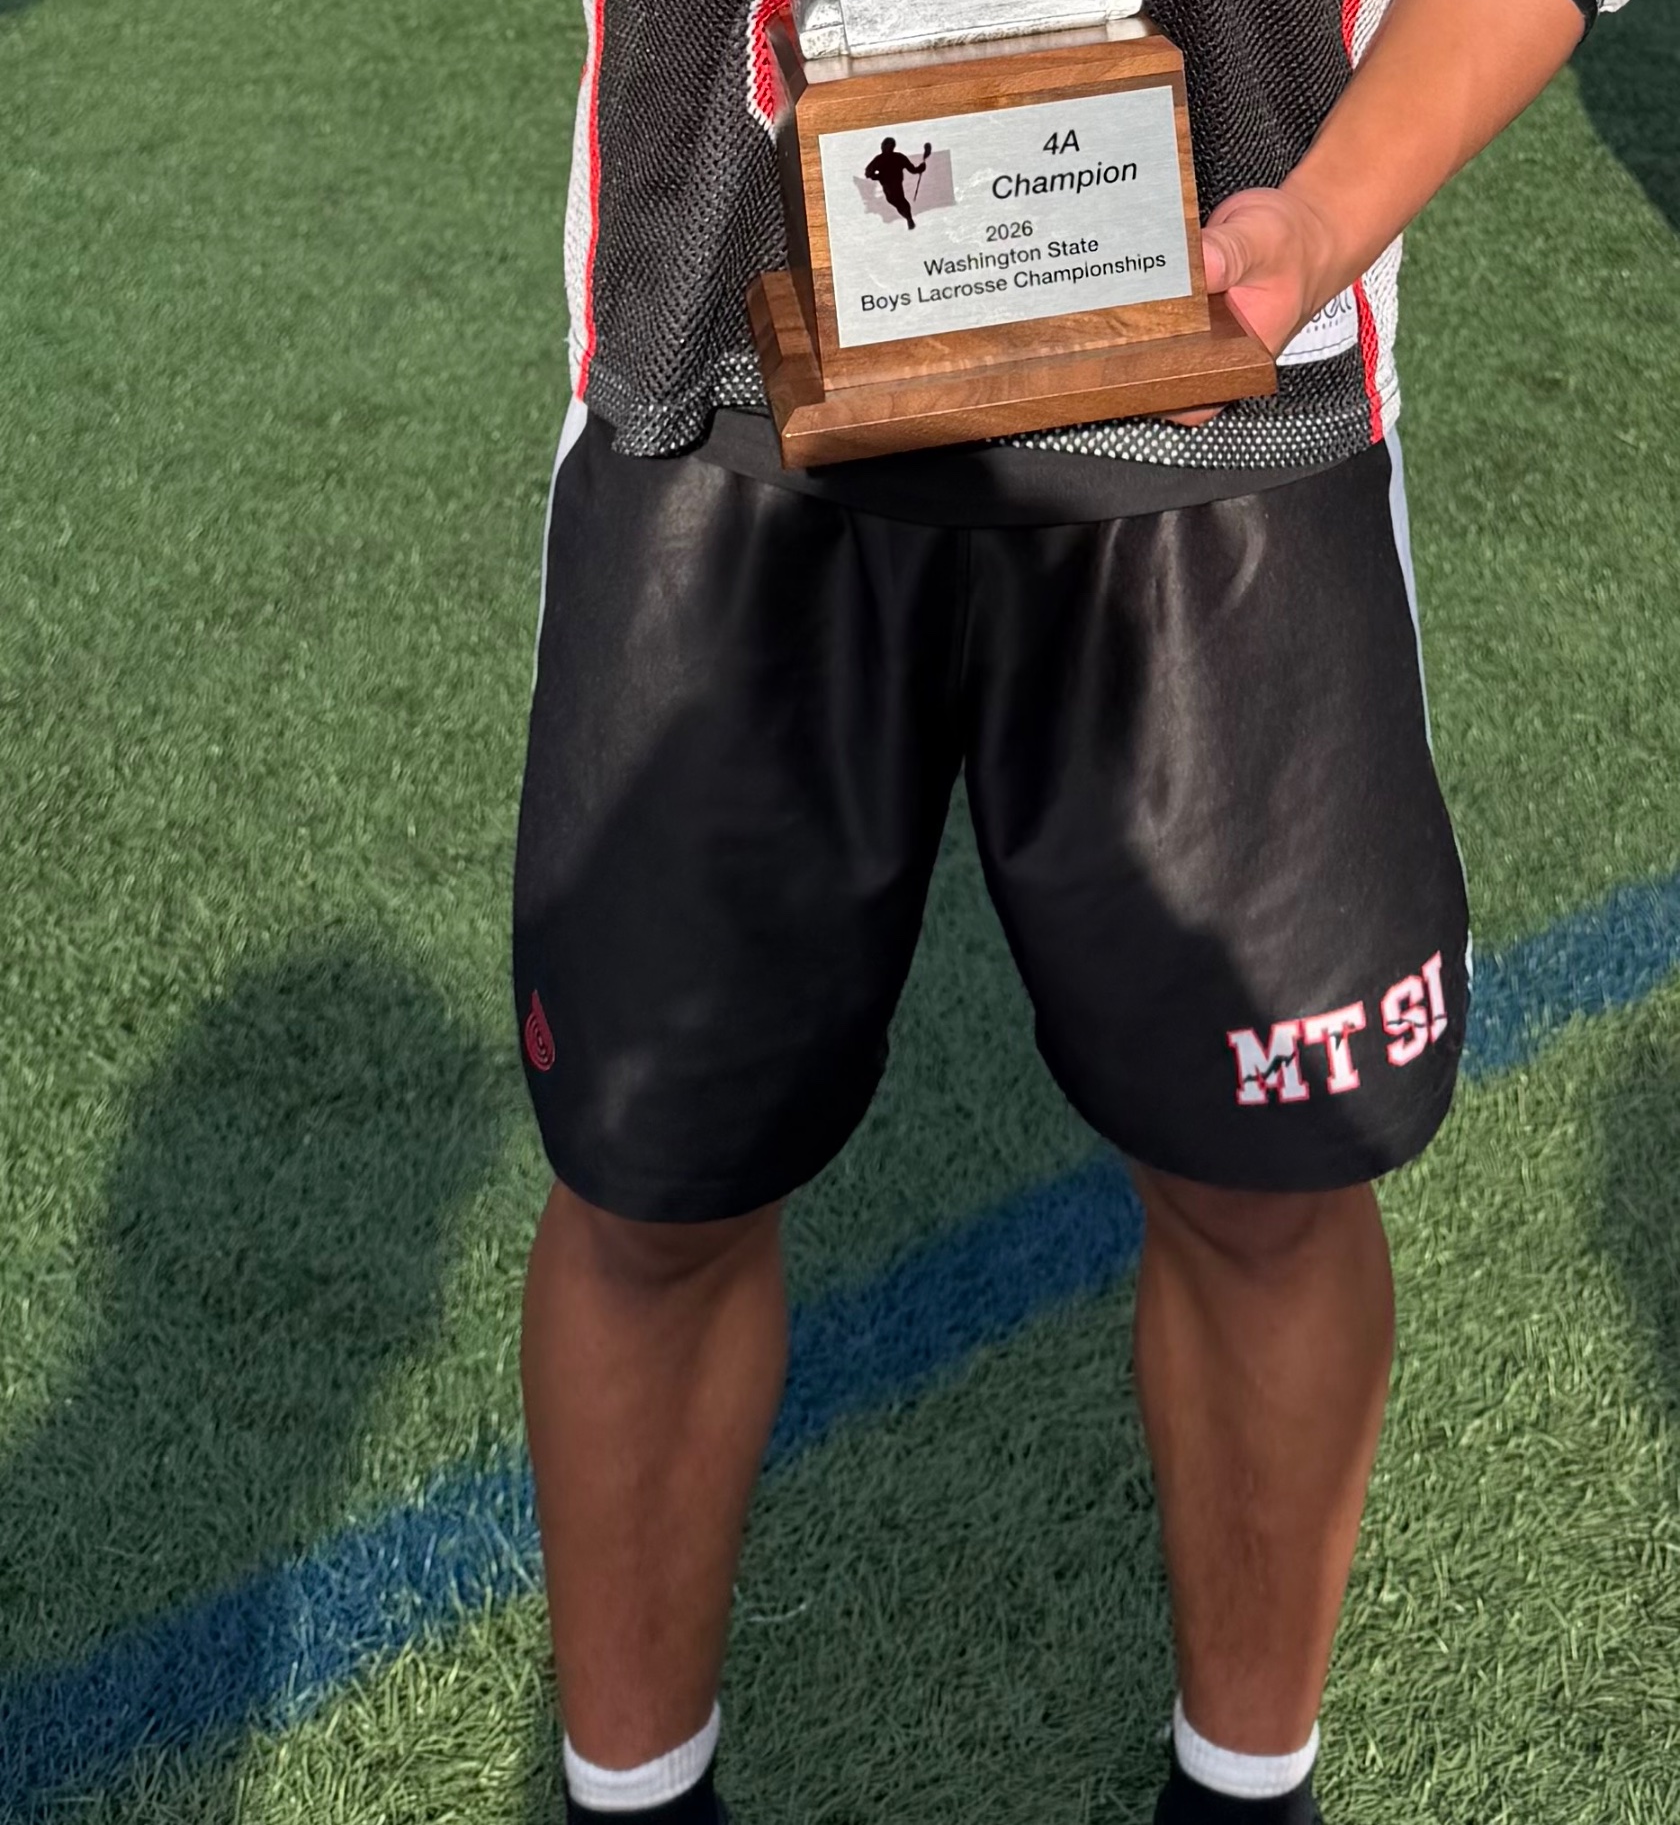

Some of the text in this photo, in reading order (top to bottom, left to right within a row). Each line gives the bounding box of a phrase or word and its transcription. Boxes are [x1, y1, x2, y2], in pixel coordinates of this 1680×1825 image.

[1043, 129, 1080, 156] 4A
[992, 161, 1138, 200] Champion
[986, 220, 1033, 242] 2026
[924, 238, 1099, 277] Washington State
[861, 252, 1167, 312] Boys Lacrosse Championships
[1225, 950, 1448, 1106] MT SI
